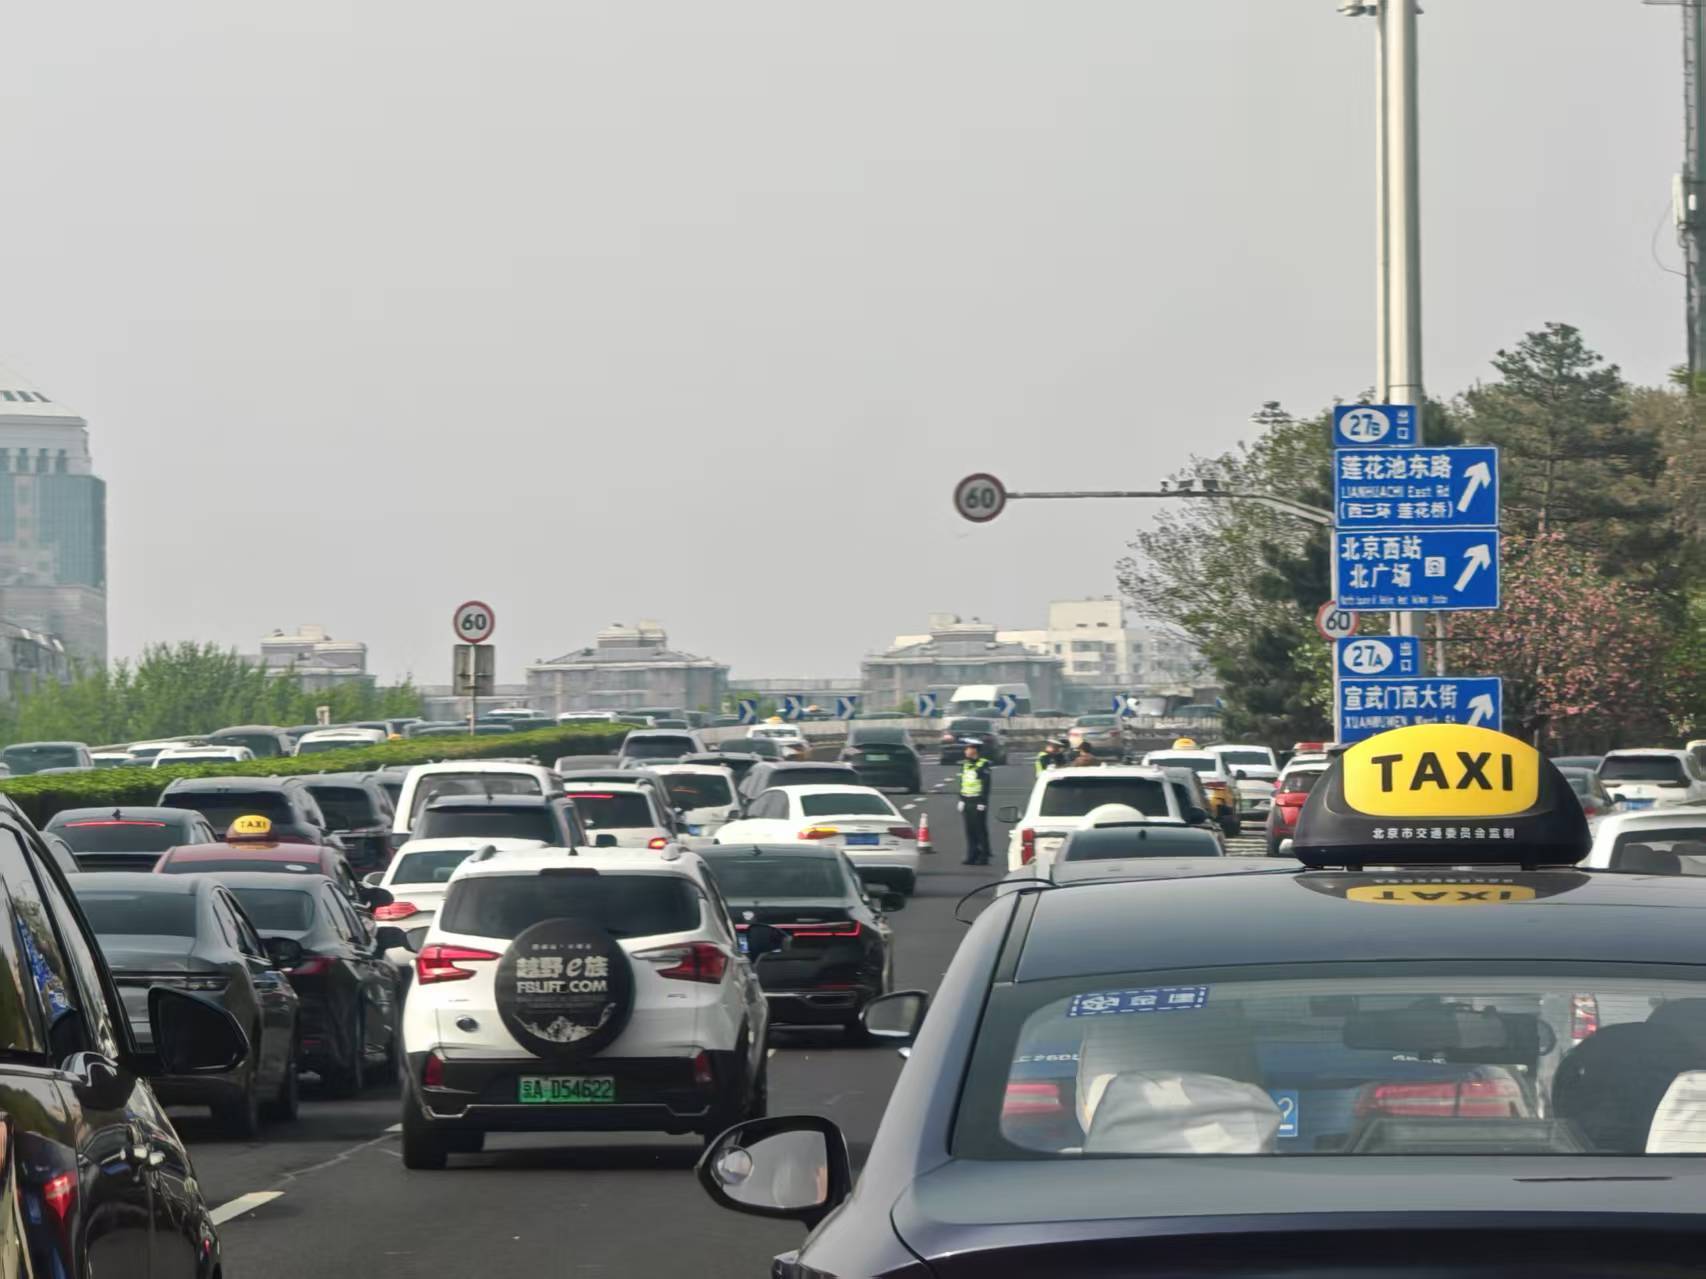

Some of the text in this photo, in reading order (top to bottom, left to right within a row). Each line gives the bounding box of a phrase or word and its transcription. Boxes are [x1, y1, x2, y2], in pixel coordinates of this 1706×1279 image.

[1396, 409, 1409, 440] 出口
[1341, 453, 1452, 480] 莲花池东路
[966, 487, 996, 509] 60
[1341, 535, 1423, 560] 北京西站
[1349, 562, 1412, 588] 北广场
[462, 613, 487, 631] 60
[1326, 611, 1351, 631] 60
[1351, 645, 1384, 668] 27A
[1400, 641, 1413, 672] 出口
[1344, 684, 1458, 711] 宣武门西大街
[1371, 751, 1513, 792] TAXI
[240, 820, 267, 829] TAXI
